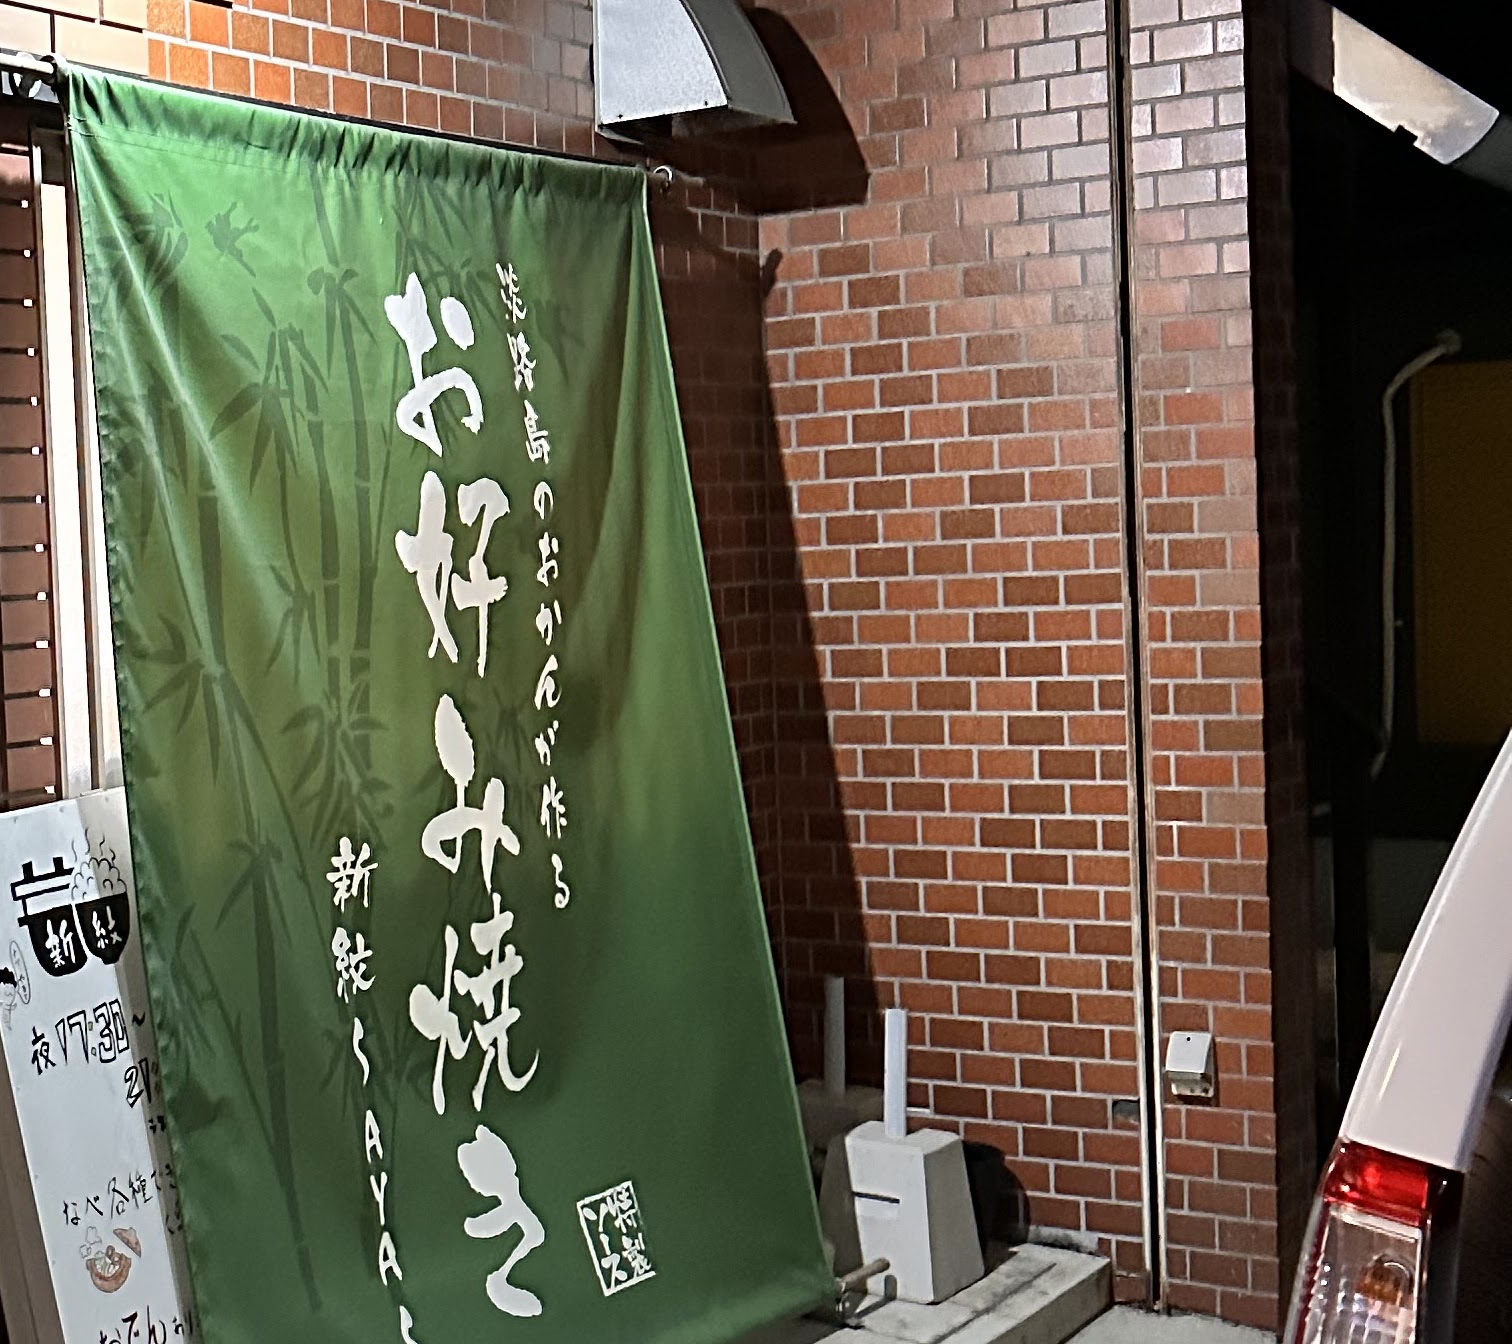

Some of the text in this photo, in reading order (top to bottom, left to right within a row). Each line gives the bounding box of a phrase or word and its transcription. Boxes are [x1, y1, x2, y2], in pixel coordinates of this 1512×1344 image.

[384, 272, 544, 1317] お好み焼き
[496, 263, 570, 908] 淡路島のおかんが作る
